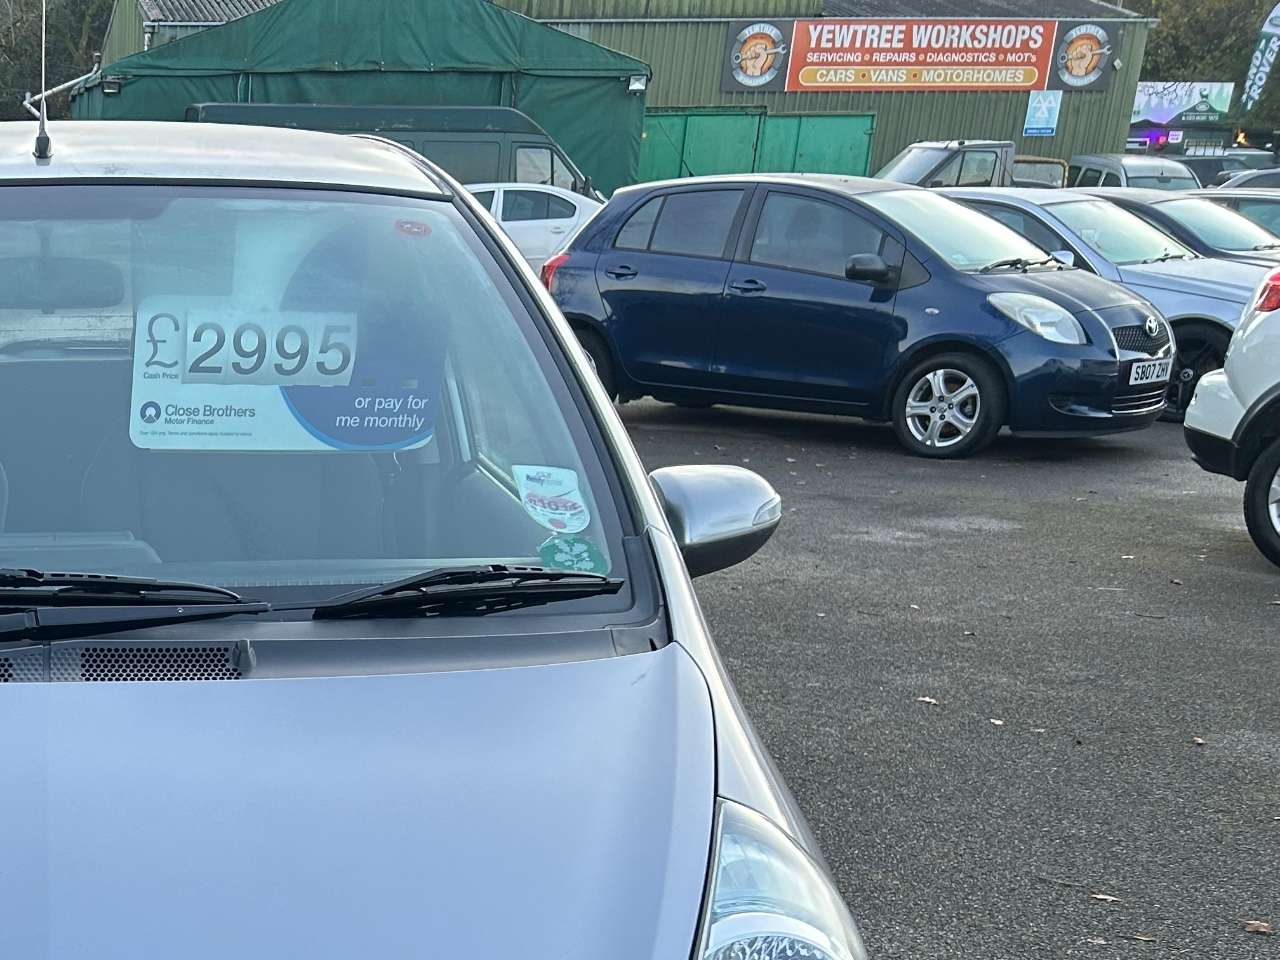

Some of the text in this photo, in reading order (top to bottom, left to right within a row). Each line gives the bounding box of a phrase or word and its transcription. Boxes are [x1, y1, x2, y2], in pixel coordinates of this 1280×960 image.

[807, 23, 1044, 49] YEWTREE WORKSHOPS
[806, 52, 862, 64] SERVICING
[872, 52, 916, 64] REPAIRS
[926, 52, 996, 64] DIAGNOSTICS
[816, 69, 1025, 83] CARS VANS MOTORHOMES
[144, 371, 160, 379] Cash
[1134, 363, 1157, 381] SB07
[165, 404, 256, 418] Close Brothers
[354, 395, 429, 412] or pay for
[336, 414, 424, 431] me monthly
